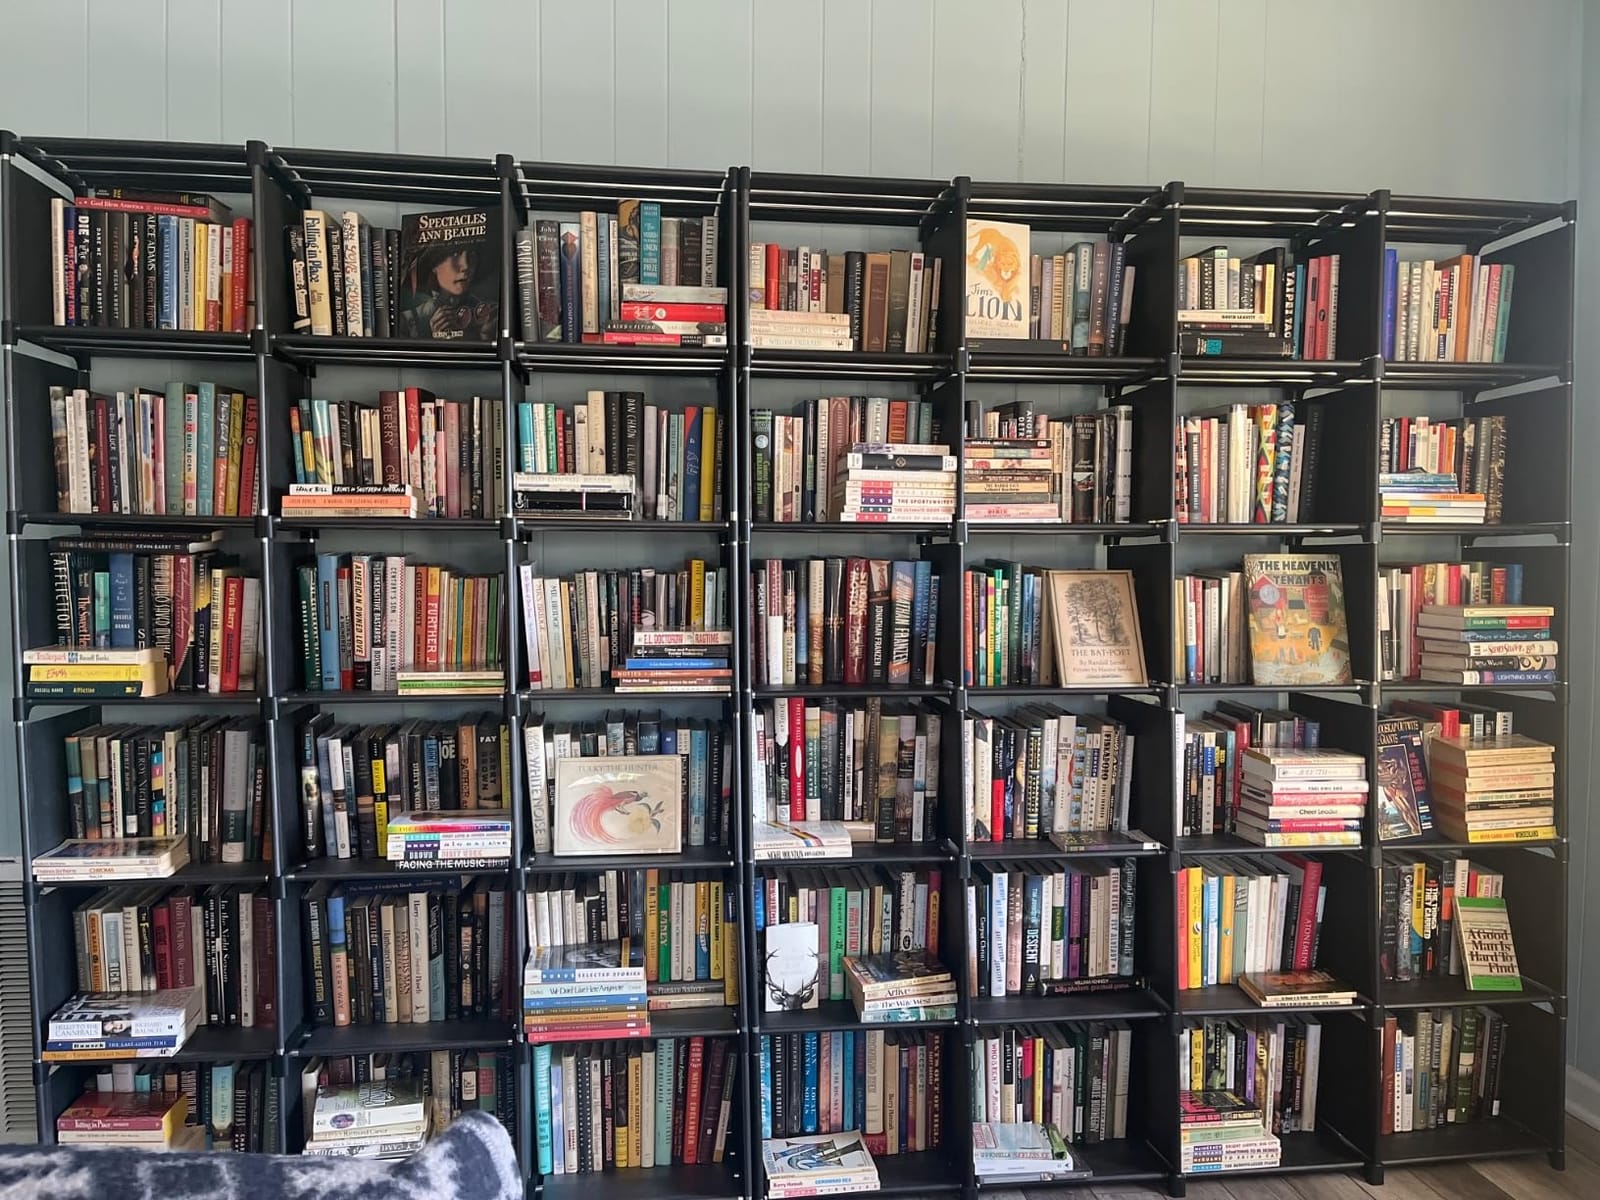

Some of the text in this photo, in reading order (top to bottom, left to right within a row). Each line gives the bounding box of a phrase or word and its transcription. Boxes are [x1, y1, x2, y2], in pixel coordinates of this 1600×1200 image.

[79, 216, 89, 235] DIE
[147, 215, 155, 237] ALICE
[418, 226, 486, 243] ANN BEATTIE
[420, 214, 486, 228] SPECTACLES
[96, 248, 102, 256] ME
[147, 242, 155, 270] ADAMS
[305, 217, 323, 283] Falling in Place
[517, 240, 532, 284] SPARTINA
[345, 246, 360, 324] LOVE ALWAYS
[1114, 247, 1122, 296] BENEDICTION
[966, 294, 1022, 322] LION
[1286, 271, 1295, 316] TAIPEI
[336, 311, 344, 333] Beattie
[340, 404, 350, 448] refund
[383, 406, 393, 446] BERRY
[626, 399, 636, 457] DAN CHAON ILL
[1258, 561, 1338, 570] THE HEAVENLY
[1274, 575, 1324, 584] TENANTS
[53, 559, 70, 630] AFFLICTION
[354, 564, 362, 603] AMERICAN
[373, 574, 381, 611] INSENSITIVE
[390, 567, 398, 600] CENTURY'S
[78, 596, 90, 632] The Sweet
[226, 583, 237, 629] Kevin Barry
[355, 606, 363, 633] OWNED
[373, 613, 382, 643] BASTARDS
[427, 602, 438, 653] FURTHER
[874, 605, 884, 666] JONATHAN FRANZEN
[892, 581, 910, 665] JONATHAN FRANZEN
[426, 743, 437, 786] LARRY BROWN
[1101, 734, 1112, 781] FISKADORO
[138, 746, 148, 815] ELROY NIGHTS
[373, 762, 381, 792] DRIVING
[412, 763, 420, 788] DIRTY
[460, 758, 469, 798] FATHER
[530, 756, 546, 835] WHITE NOISE
[399, 858, 486, 870] FACING THE MUSIC
[310, 902, 318, 919] LARRY
[1403, 875, 1412, 914] Going After
[310, 920, 320, 939] BROWN
[1301, 918, 1313, 968] ATONEMENT
[1468, 930, 1508, 940] A Good
[1472, 940, 1512, 951] Man Is
[312, 946, 322, 970] MIRACLE
[1026, 930, 1039, 964] DESCENT
[1470, 951, 1514, 962] Hard To
[1488, 963, 1515, 973] Find
[314, 979, 324, 1002] CATFISH
[1092, 1038, 1102, 1050] SOIL
[1091, 1077, 1101, 1098] JAMIE
[234, 1090, 246, 1127] BELIEVERS
[687, 1102, 697, 1145] ENGLANDER
